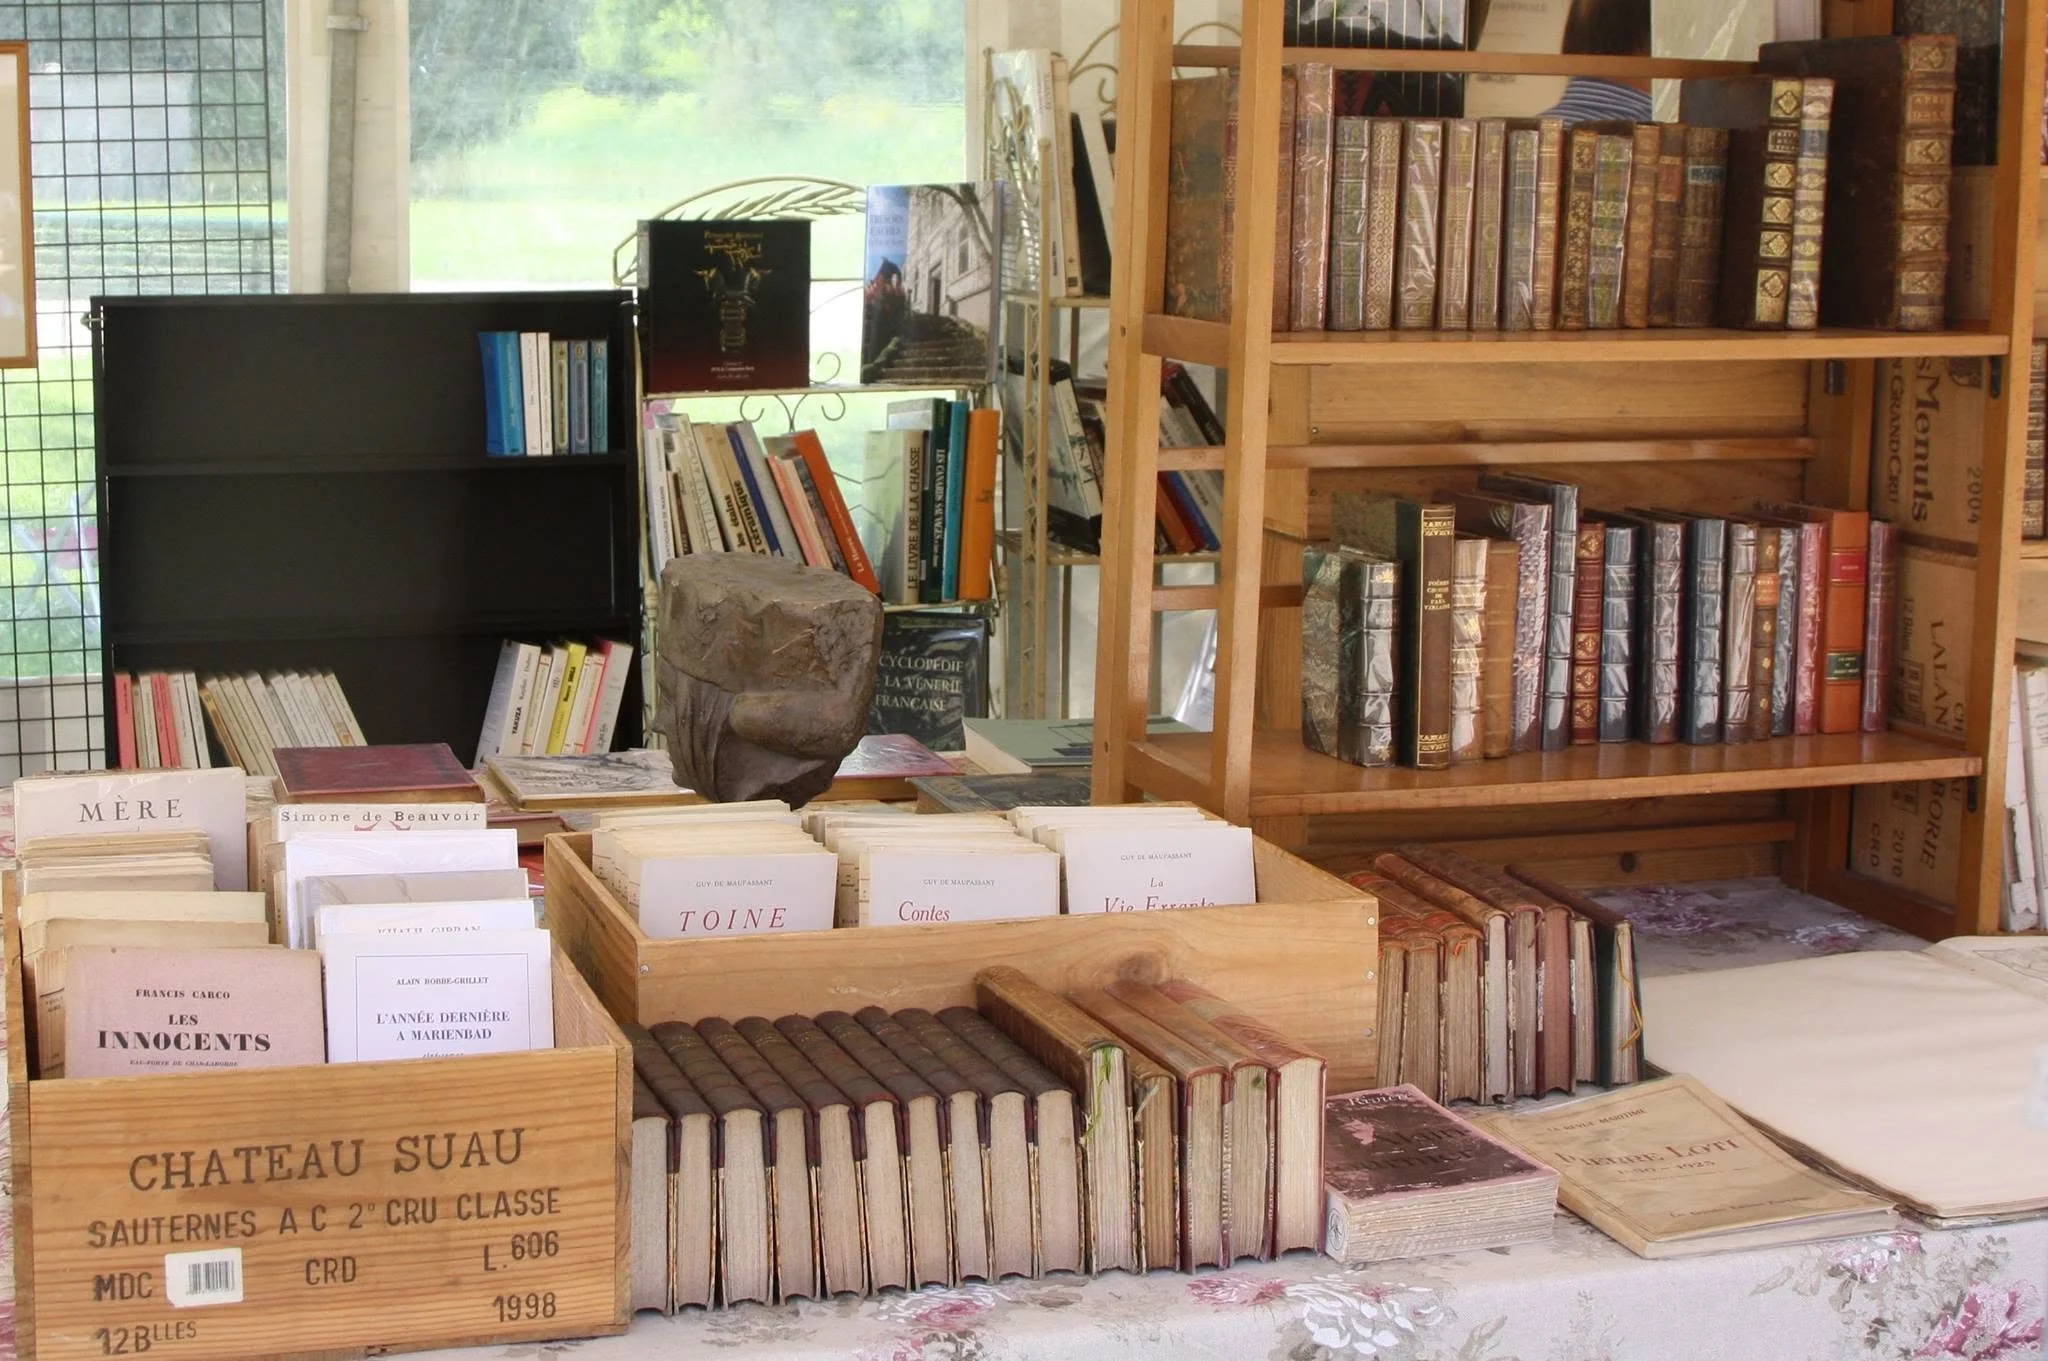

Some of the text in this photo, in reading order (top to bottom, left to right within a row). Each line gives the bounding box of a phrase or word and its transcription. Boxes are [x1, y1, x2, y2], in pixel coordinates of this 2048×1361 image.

[1967, 466, 1983, 525] 2004
[907, 446, 920, 589] LE LIVRE DE LA CHASSE
[885, 676, 900, 687] LA
[78, 795, 183, 823] MÈRE
[281, 811, 482, 822] Simone de Beauvoir
[1148, 852, 1192, 860] MAUPASSANT
[1891, 829, 1905, 877] 2010
[696, 880, 710, 888] GUY
[726, 879, 774, 887] MAUPASSANT
[950, 879, 995, 887] MAUPASSANT
[1150, 877, 1164, 888] La
[898, 900, 950, 922] Contes
[679, 907, 787, 933] TOINE
[424, 976, 489, 985] ROBBE-GRILLET
[136, 988, 231, 1000] FRANCIS CARCO
[168, 1014, 198, 1026] LES
[376, 1008, 511, 1024] L'ANNÉE DERNIÈRE
[96, 1030, 272, 1052] INNOCENTS
[396, 1028, 493, 1041] A MARIENBAD
[1598, 1107, 1648, 1124] MARITIME
[129, 1127, 526, 1191] CHATEAU SUAU
[88, 1210, 257, 1249] SAUTERNES
[279, 1207, 298, 1235] A
[311, 1204, 327, 1232] C
[386, 1196, 438, 1226] CRU
[456, 1187, 562, 1222] CLASSE
[93, 1255, 357, 1302] MDC CRD
[492, 1291, 558, 1323] 1998
